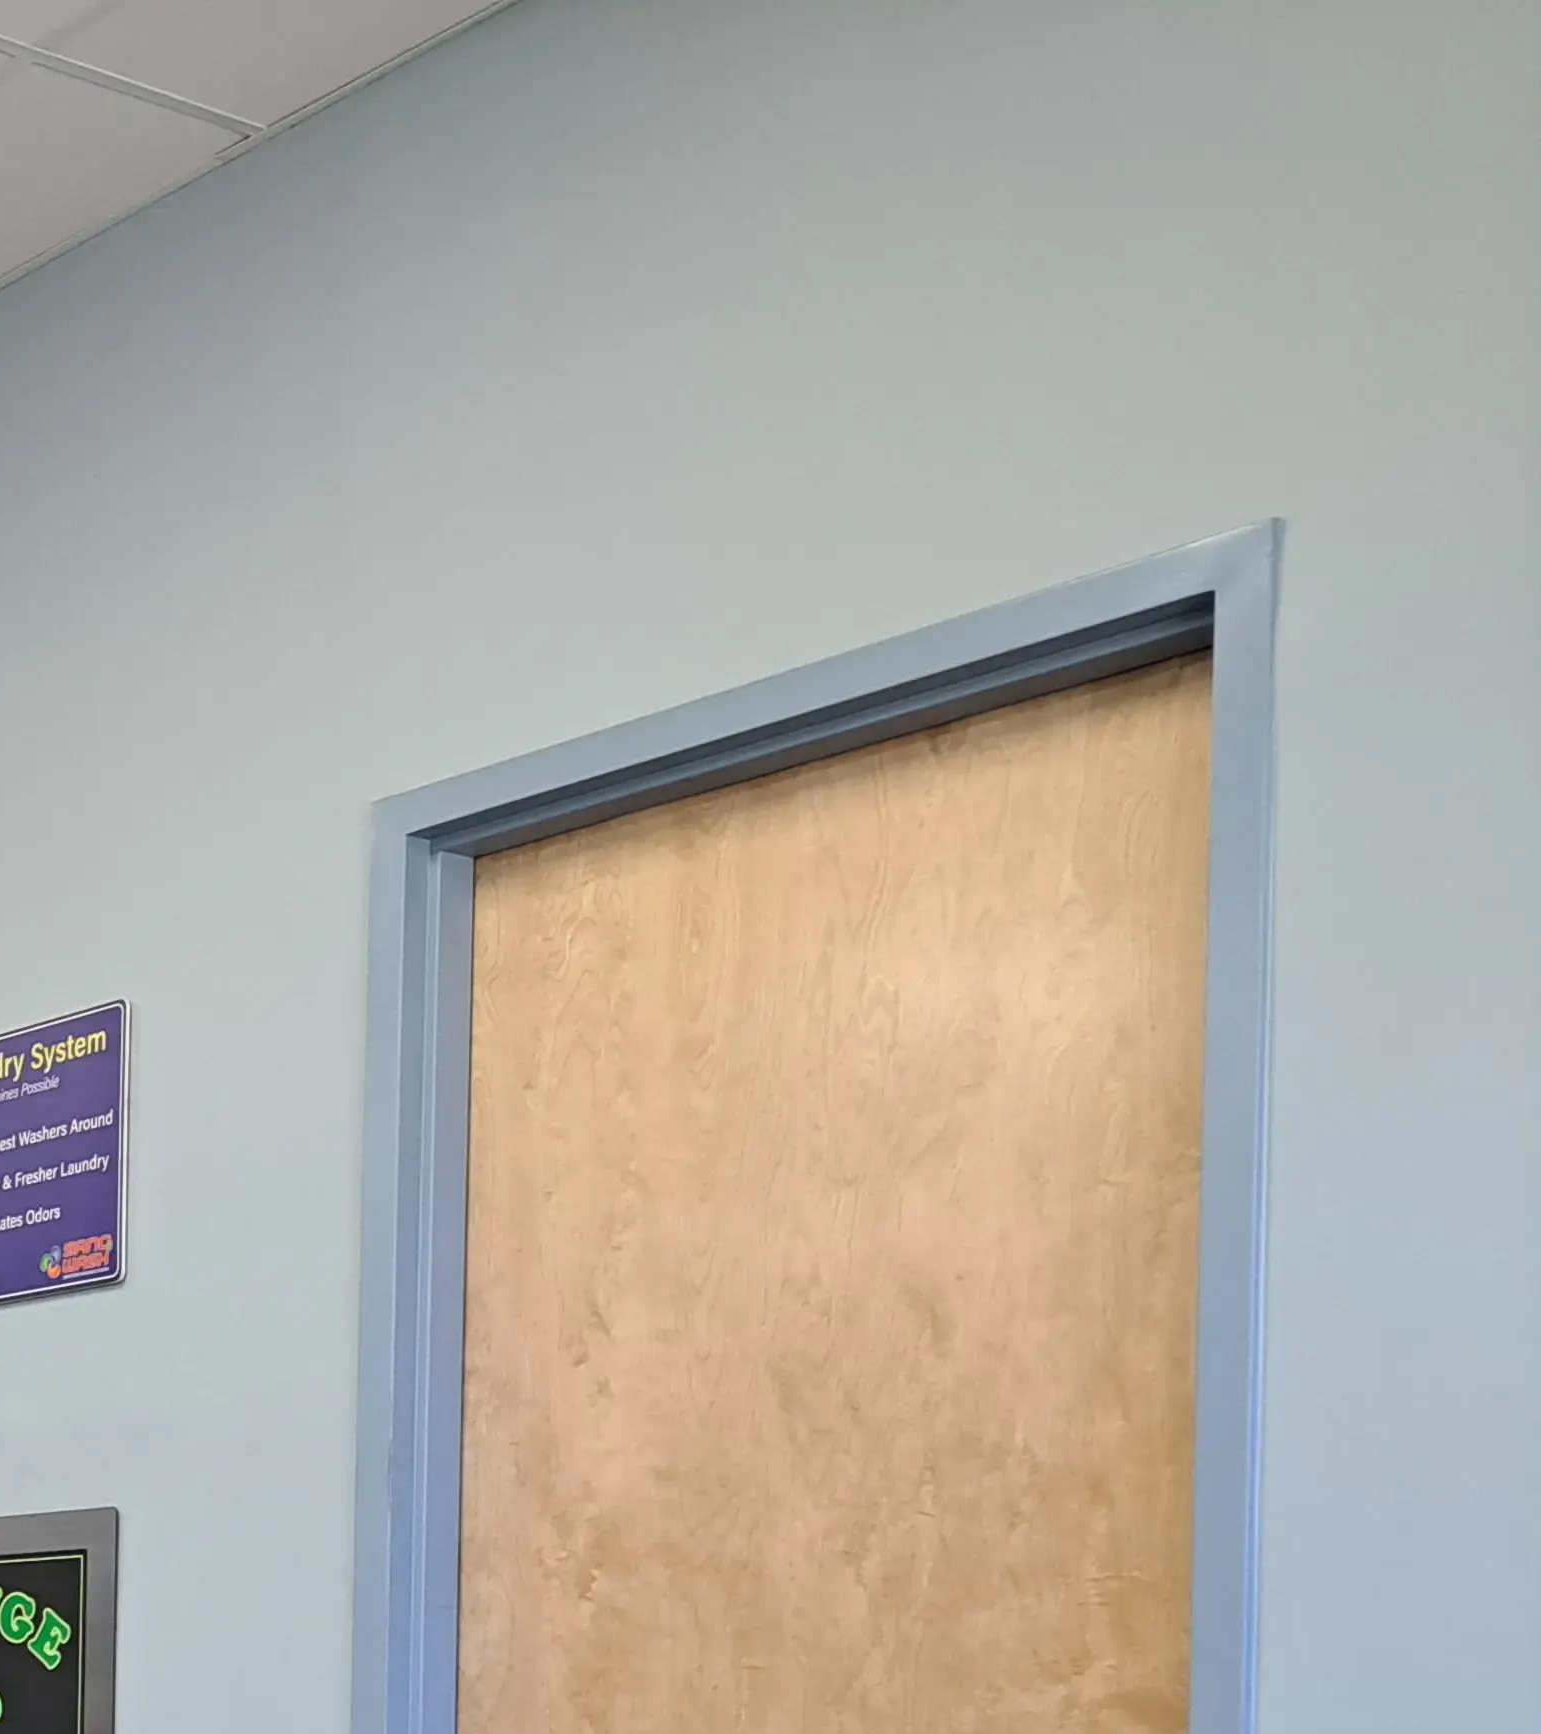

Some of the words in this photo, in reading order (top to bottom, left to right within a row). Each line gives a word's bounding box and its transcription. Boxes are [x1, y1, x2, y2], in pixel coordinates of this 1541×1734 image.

[30, 1030, 107, 1073] System
[21, 1075, 60, 1097] Possible
[19, 1122, 67, 1147] Washers
[70, 1109, 113, 1135] Around
[2, 1175, 12, 1190] &
[15, 1165, 58, 1189] Fresher
[60, 1154, 110, 1178] Laundry
[26, 1205, 61, 1226] Odors
